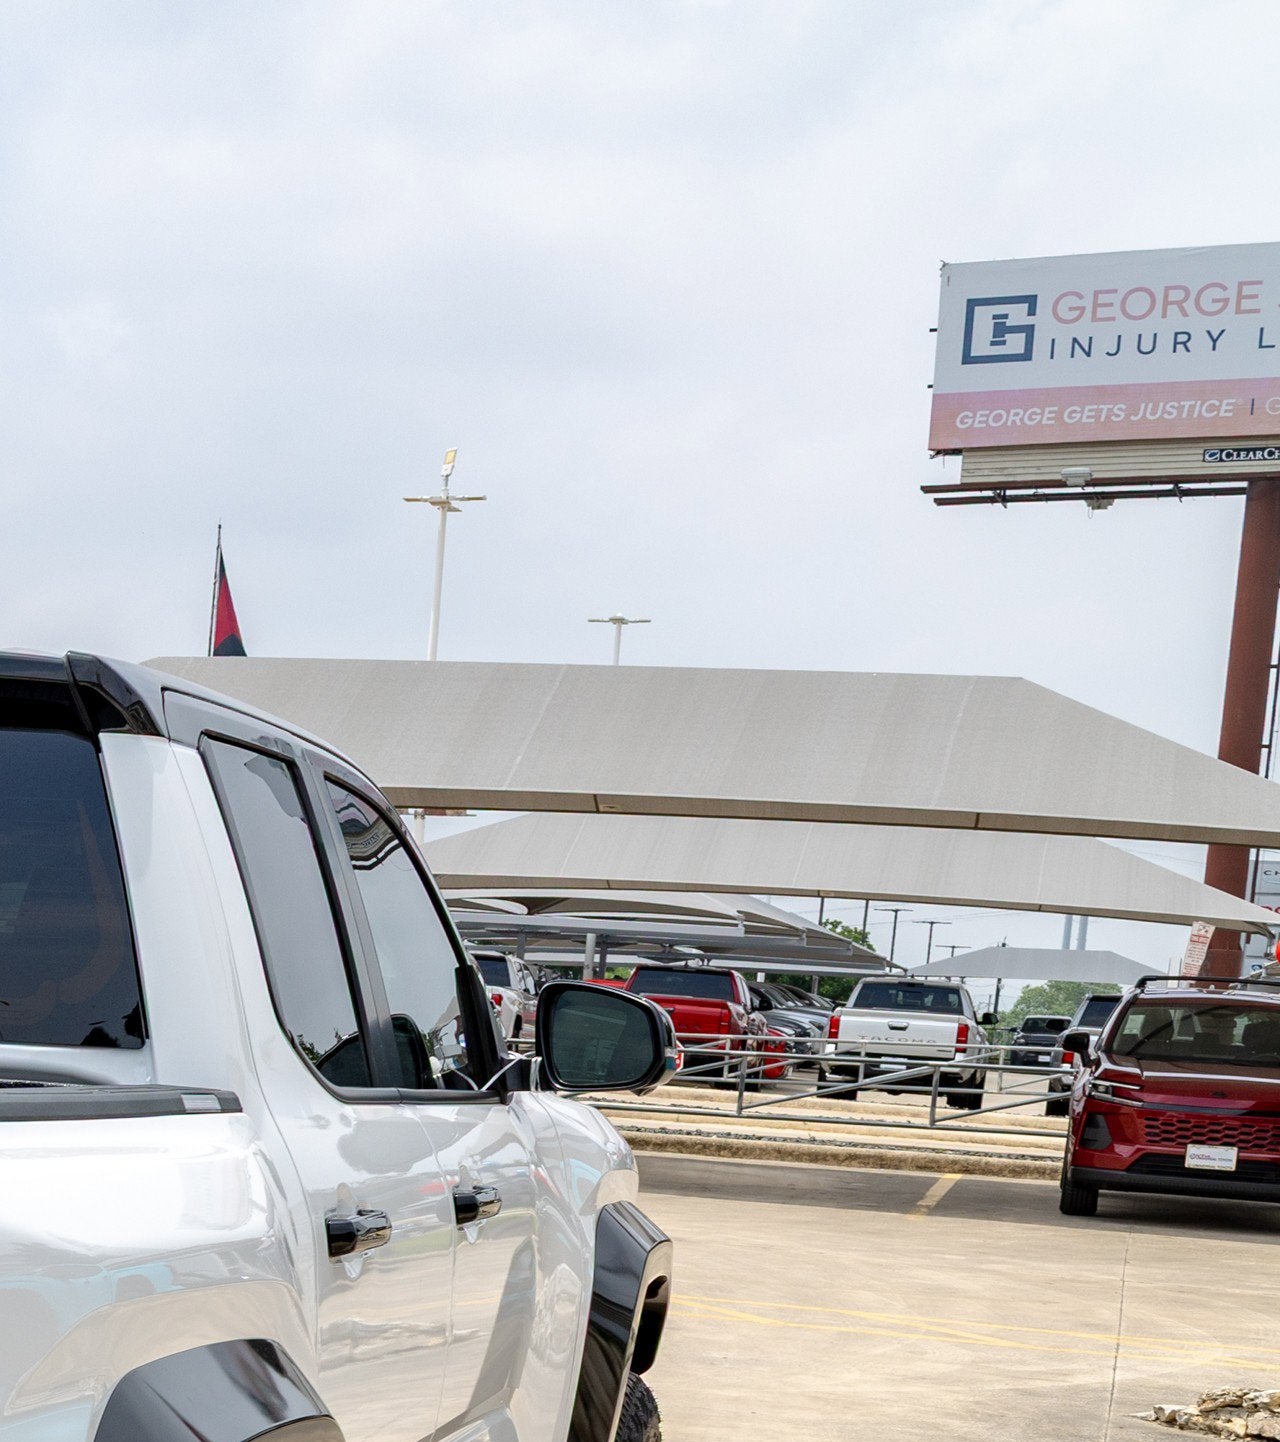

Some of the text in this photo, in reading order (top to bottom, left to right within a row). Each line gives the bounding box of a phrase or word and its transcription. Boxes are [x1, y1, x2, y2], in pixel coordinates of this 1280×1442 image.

[1051, 279, 1264, 325] GEORGE
[1049, 328, 1227, 360] INJURY
[955, 406, 1058, 429] GEORGE
[1063, 403, 1126, 424] GETS
[1130, 398, 1236, 421] JUSTICE
